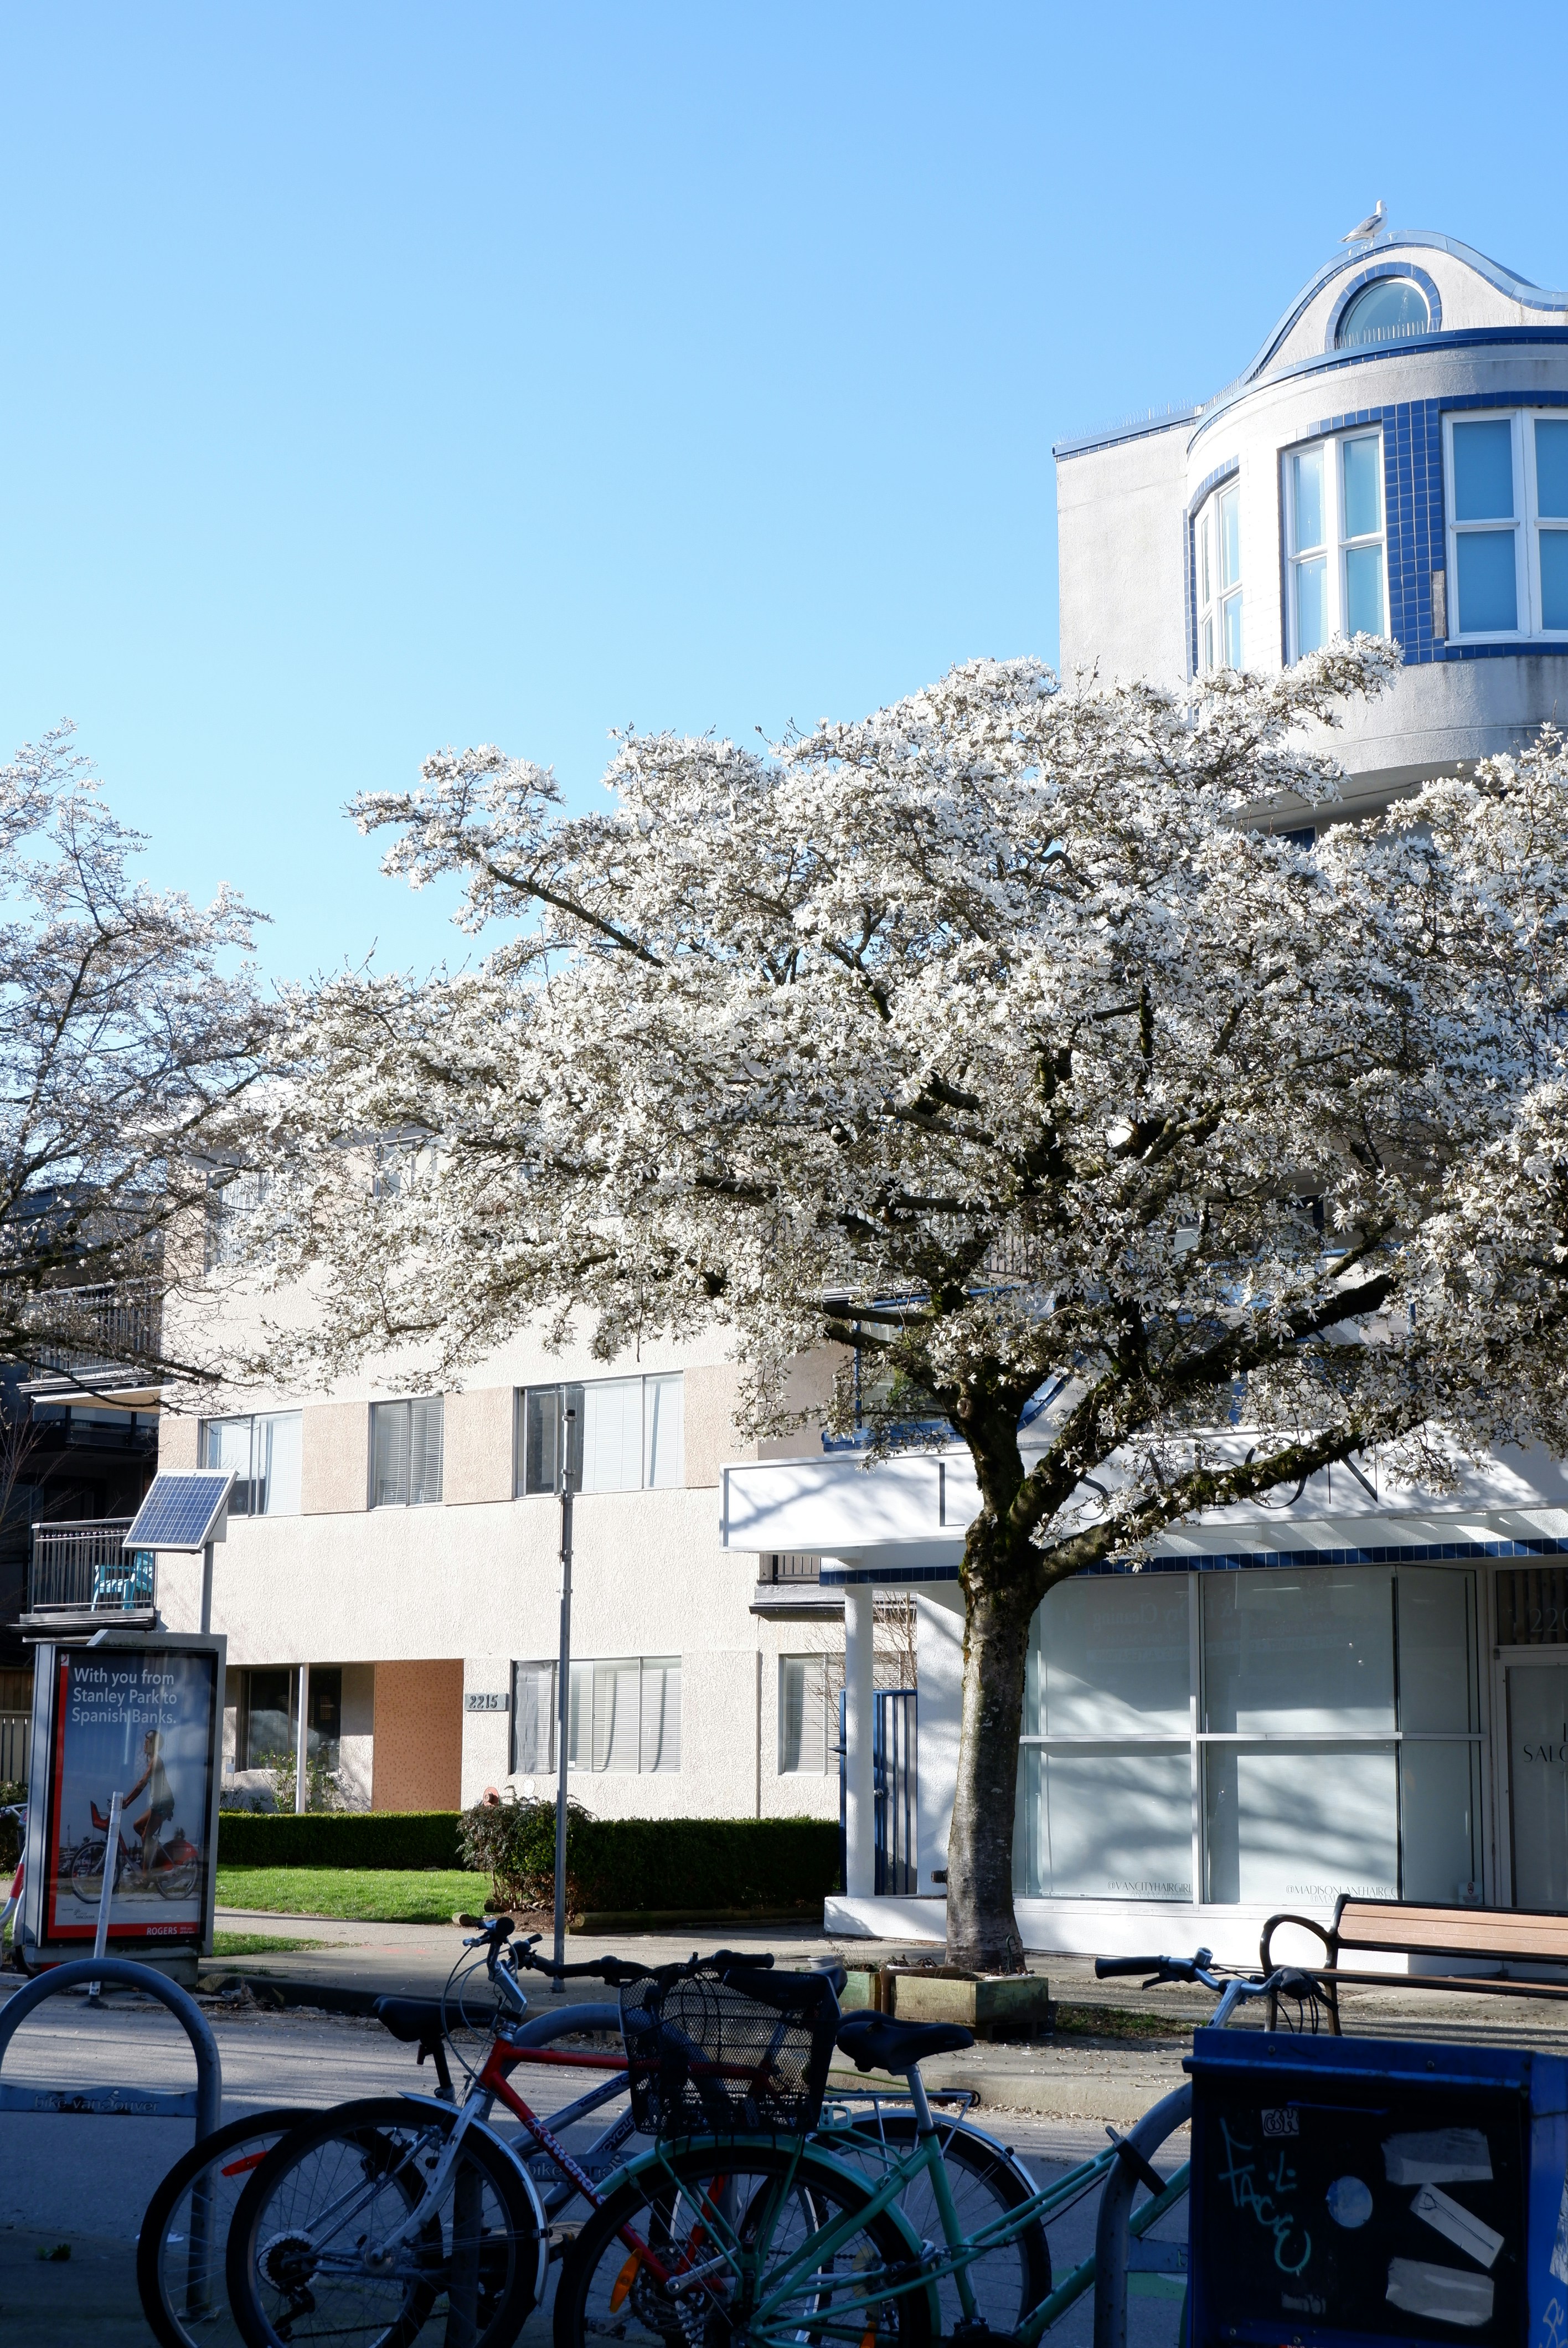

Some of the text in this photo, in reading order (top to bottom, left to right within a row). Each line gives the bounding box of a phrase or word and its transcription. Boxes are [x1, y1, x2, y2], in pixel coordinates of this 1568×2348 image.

[74, 1667, 174, 1687] With you from
[73, 1687, 177, 1707] Stanley Park to
[470, 1695, 498, 1708] 2215
[72, 1707, 177, 1726] Spanish Banks.
[147, 1927, 178, 1935] ROGERS
[34, 2094, 160, 2112] bike vancouver
